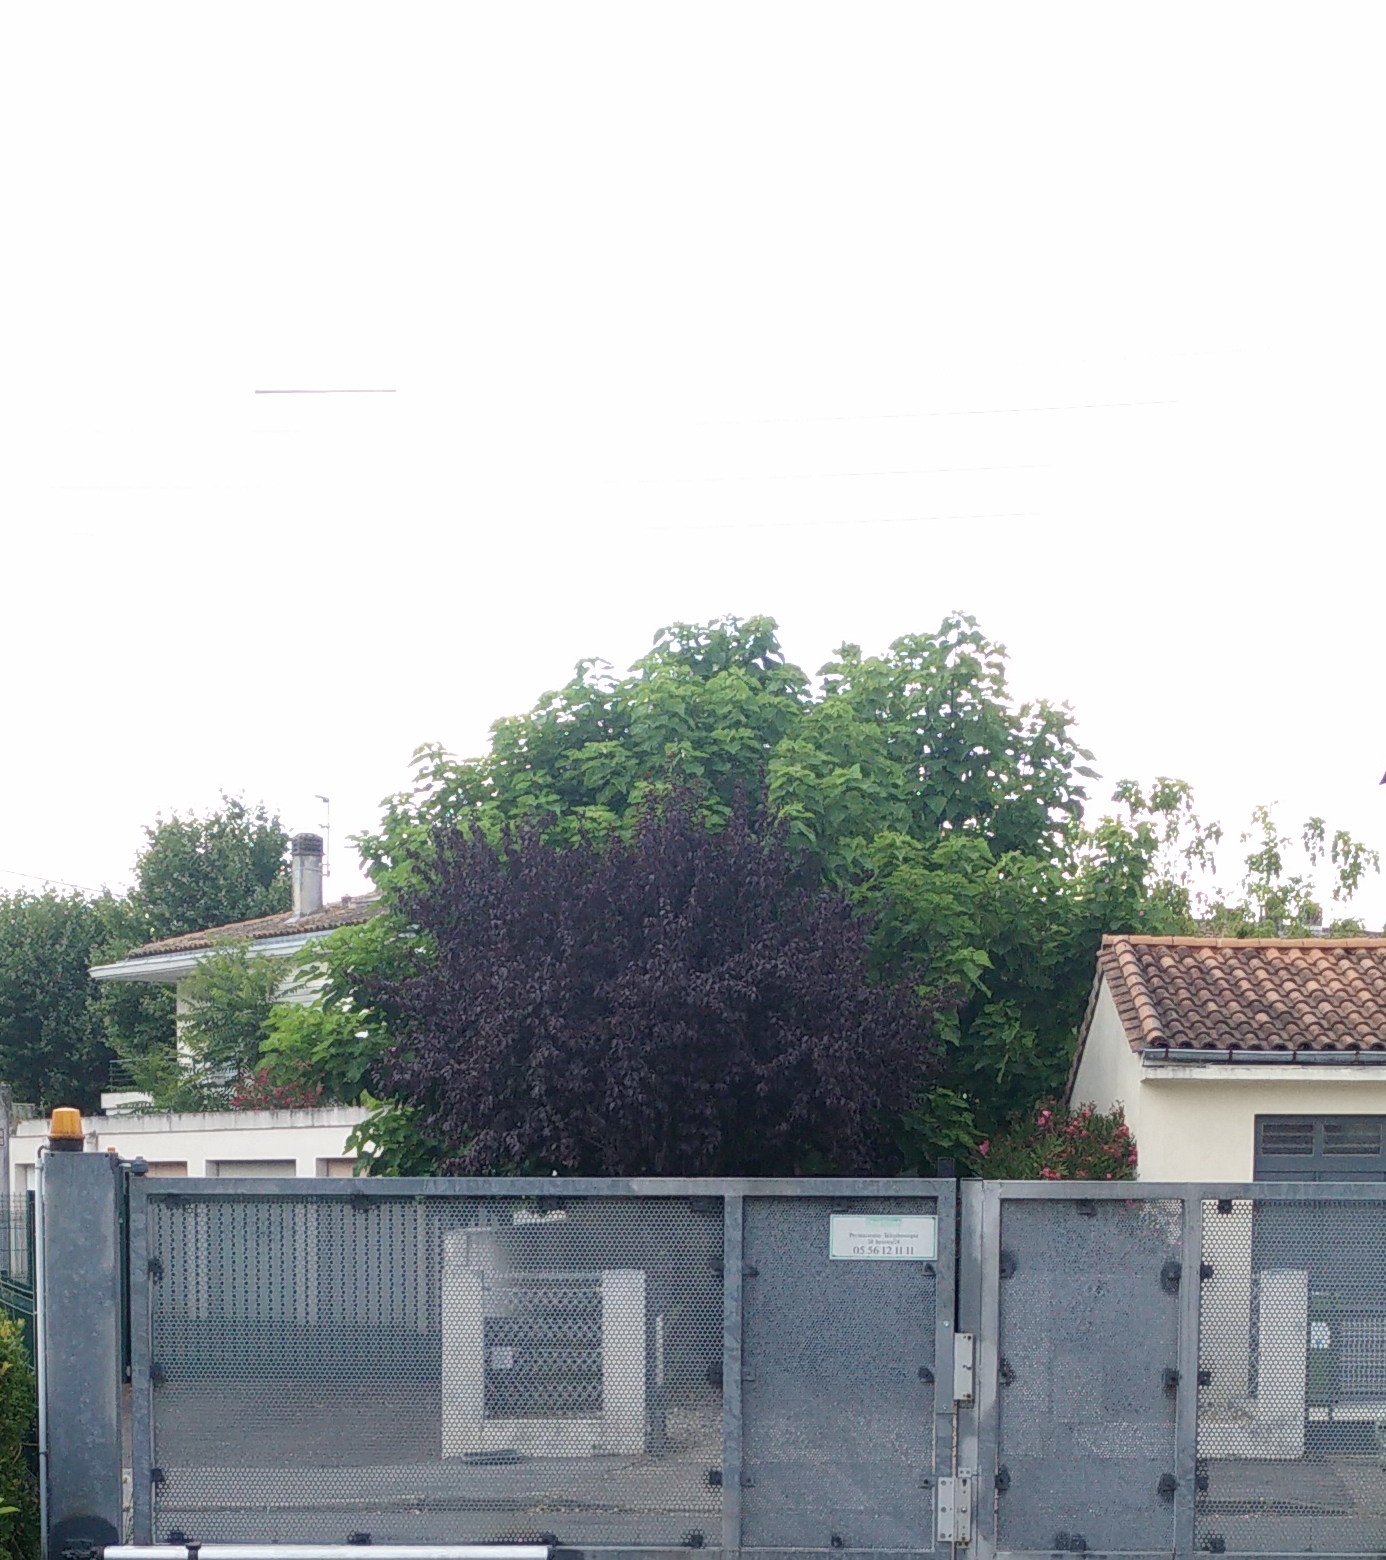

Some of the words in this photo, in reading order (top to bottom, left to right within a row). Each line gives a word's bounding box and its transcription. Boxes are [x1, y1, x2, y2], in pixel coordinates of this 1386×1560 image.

[853, 1245, 865, 1255] 05
[867, 1245, 879, 1255] 56
[882, 1245, 892, 1255] 12
[895, 1245, 902, 1255] 11
[906, 1245, 914, 1255] 11
